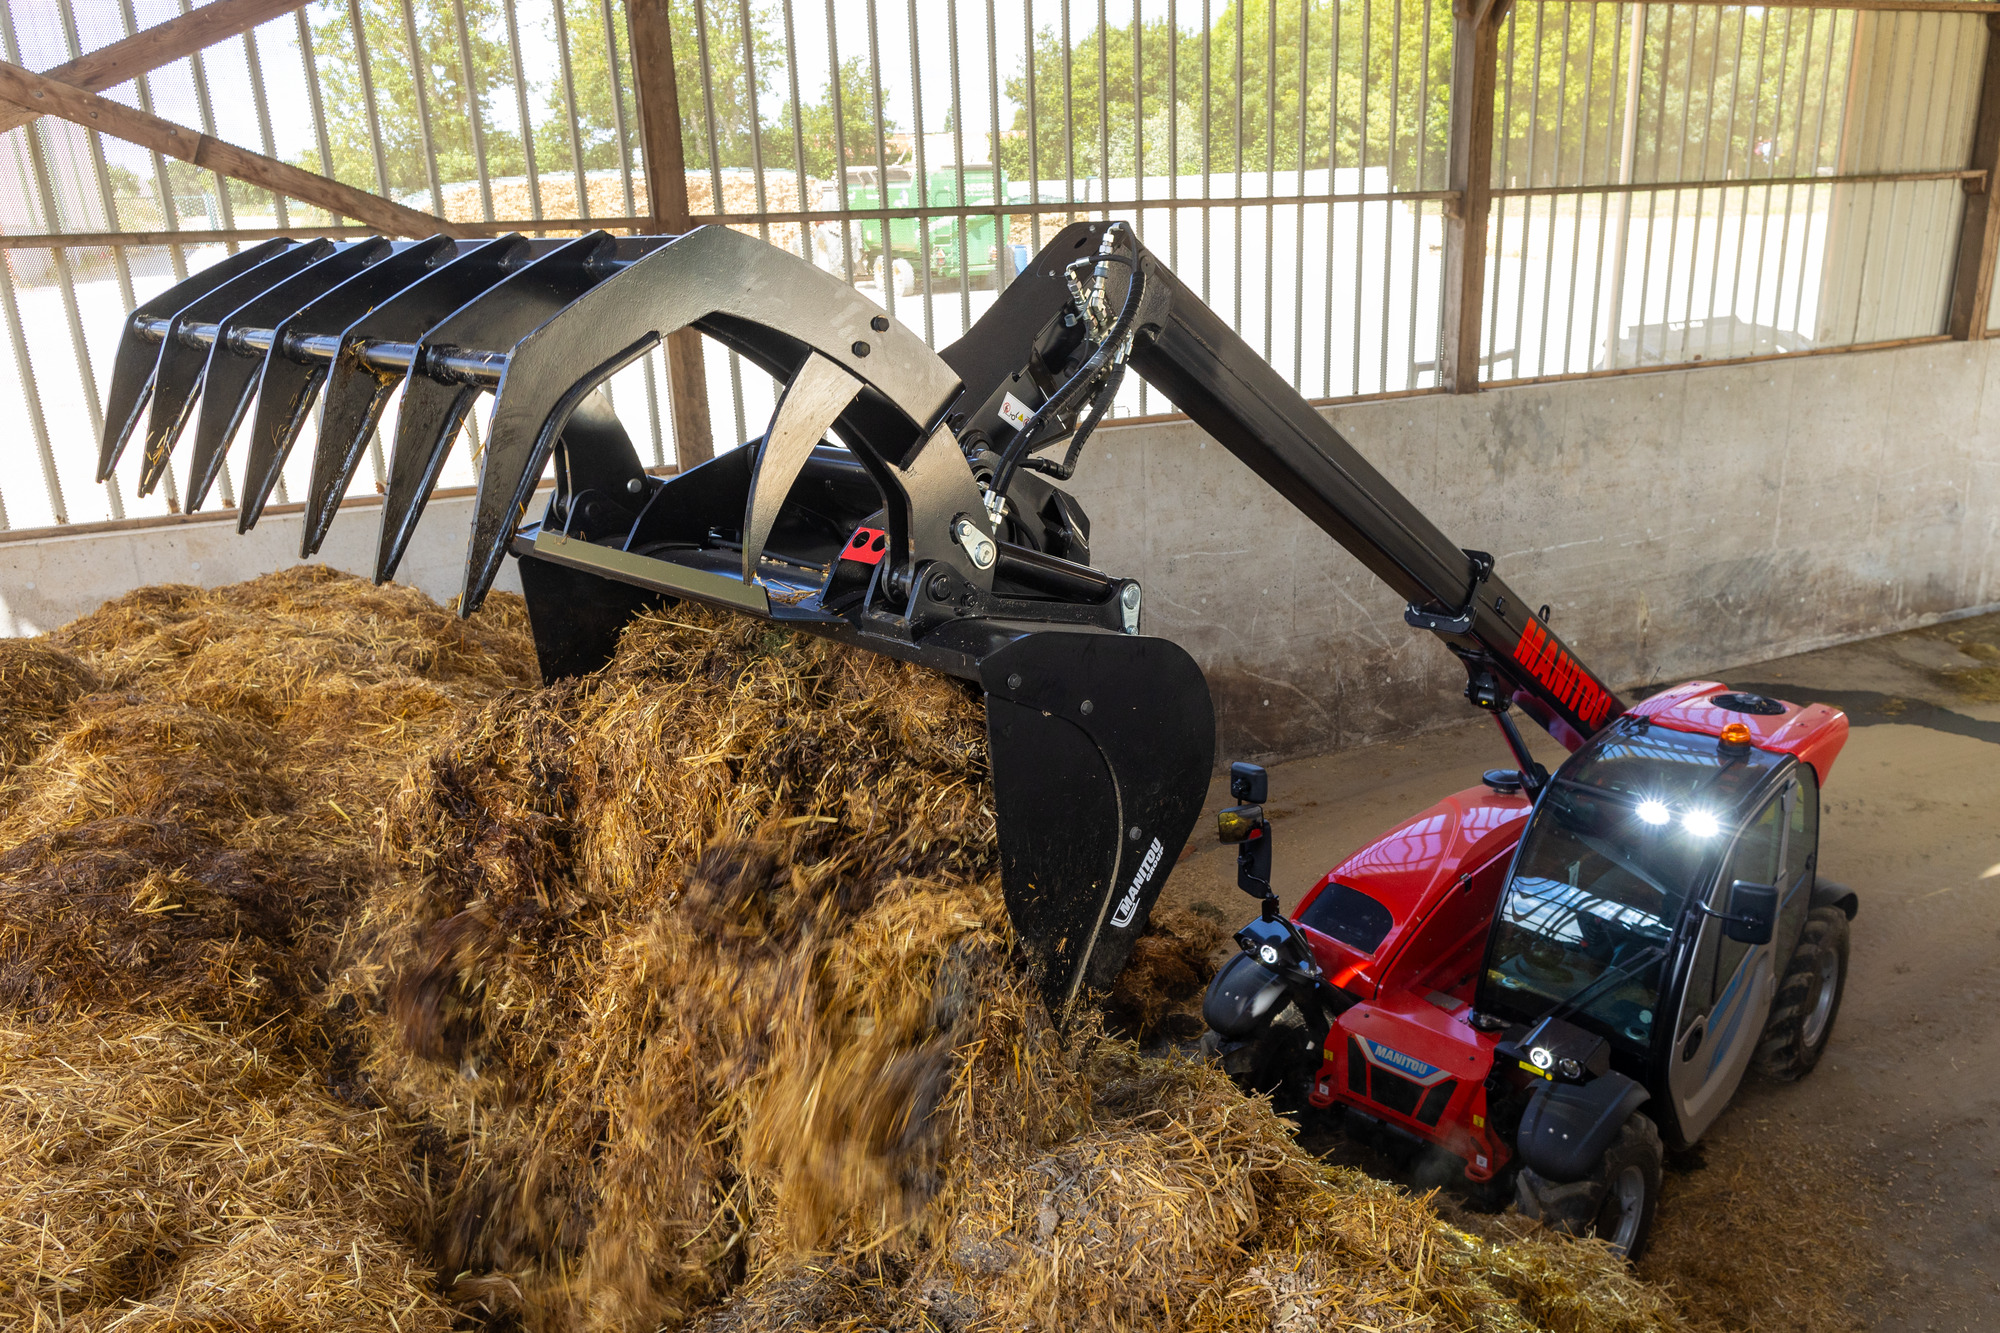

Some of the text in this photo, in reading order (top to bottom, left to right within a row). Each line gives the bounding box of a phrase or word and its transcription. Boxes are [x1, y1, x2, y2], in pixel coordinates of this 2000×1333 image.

[1513, 616, 1612, 731] MANITOU
[1119, 836, 1162, 917] MANITOU
[1146, 846, 1164, 882] GROUP
[1374, 1045, 1428, 1075] MANITOU
